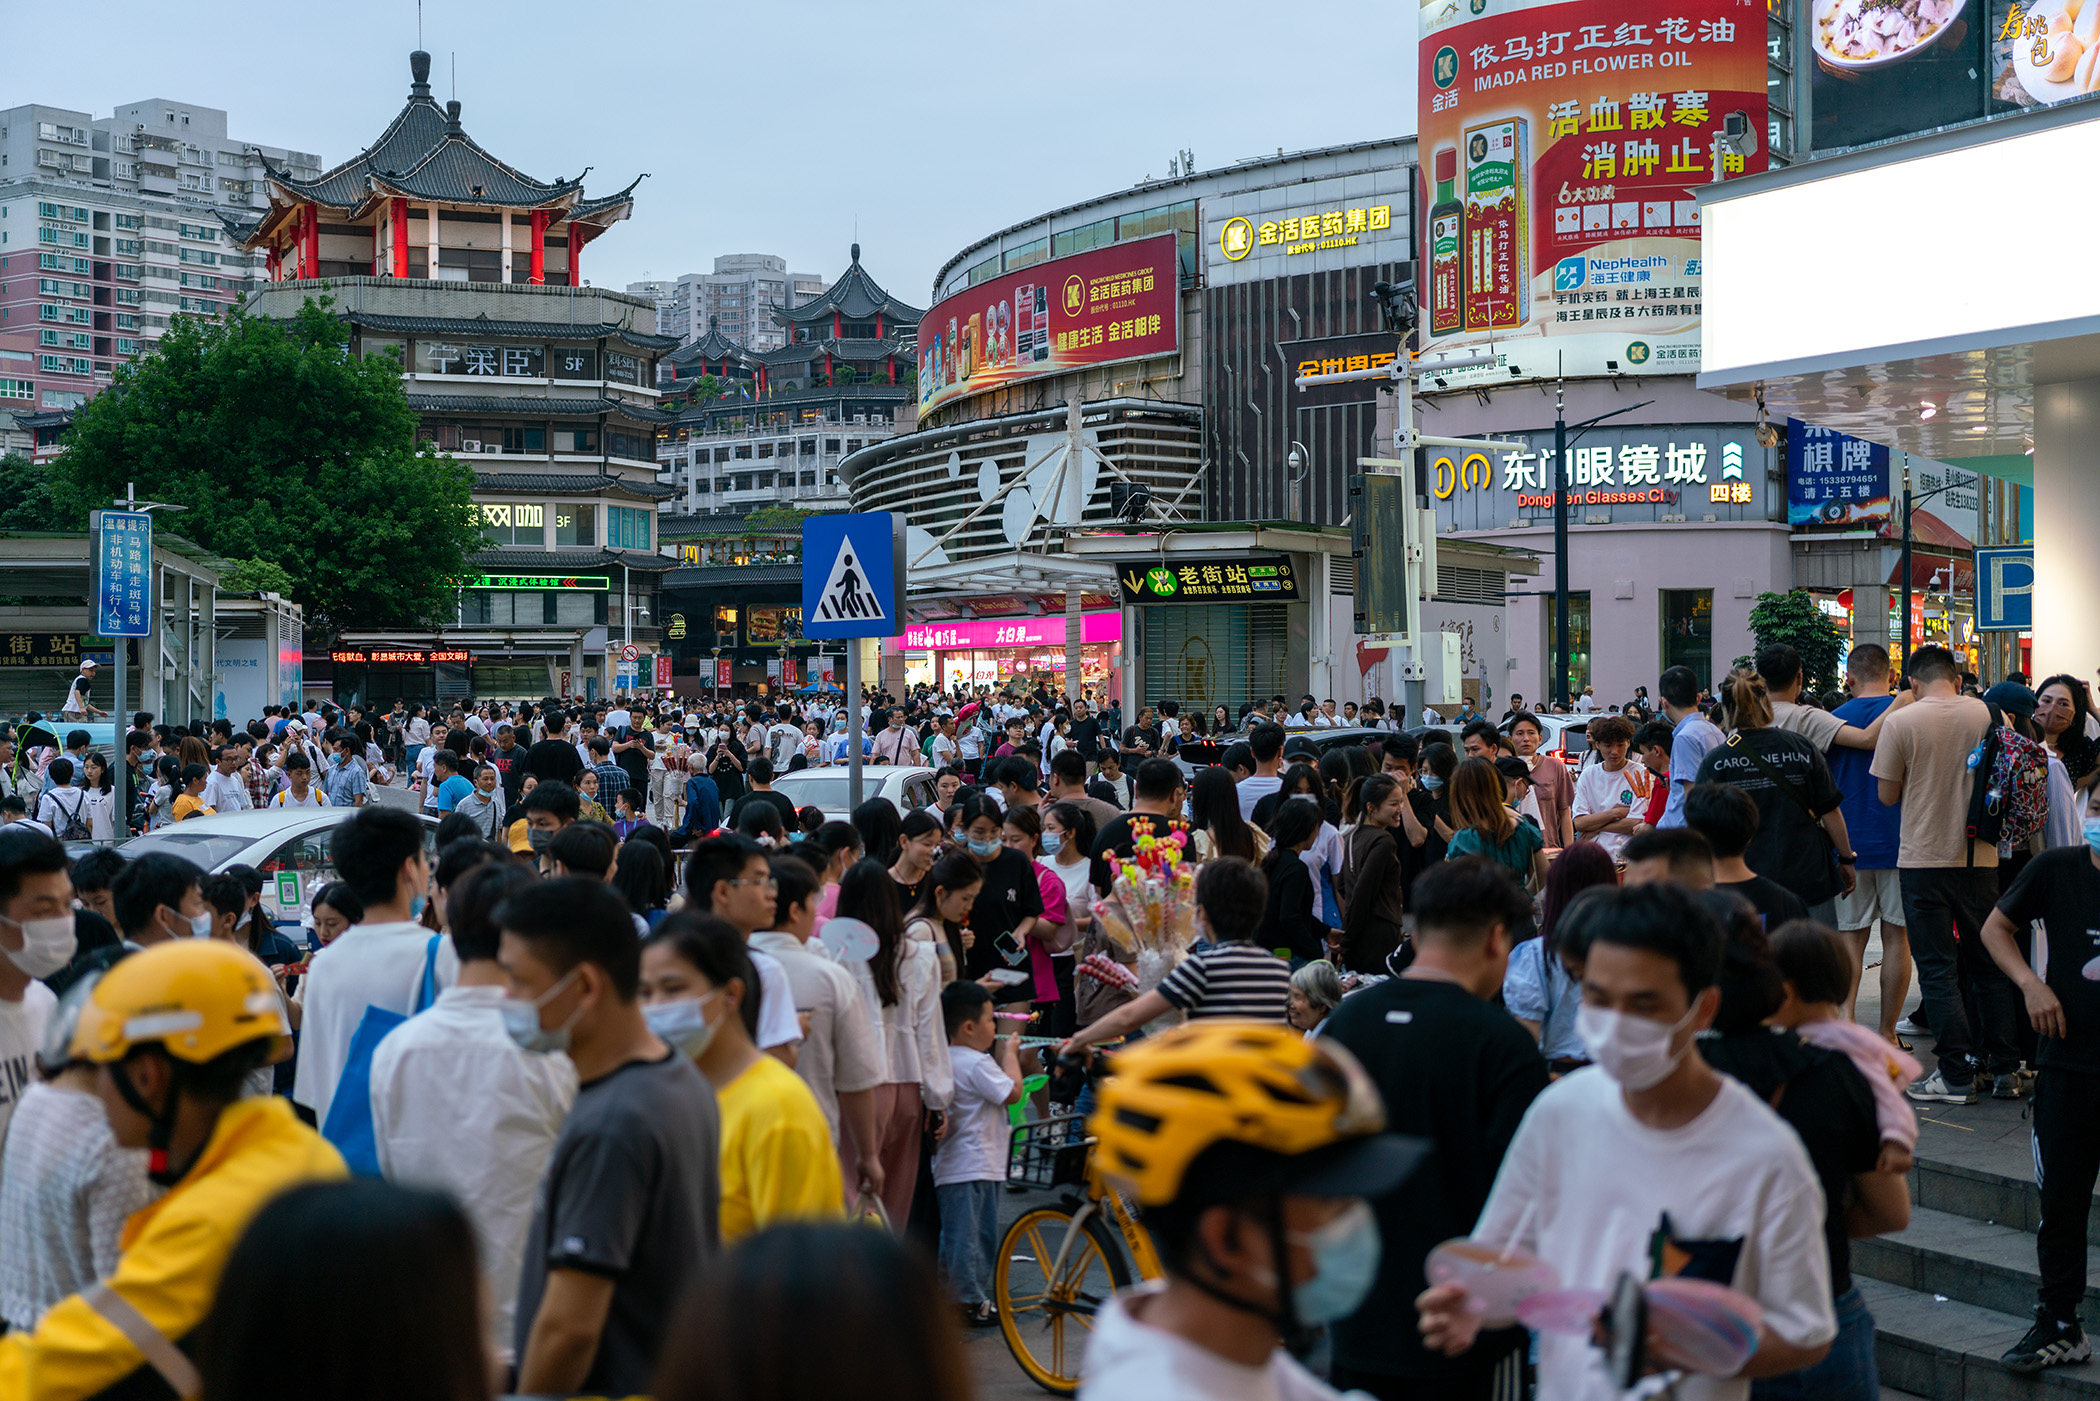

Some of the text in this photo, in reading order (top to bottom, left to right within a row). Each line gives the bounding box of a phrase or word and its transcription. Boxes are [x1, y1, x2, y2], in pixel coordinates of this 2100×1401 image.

[1469, 16, 1736, 71] 依马打正红花油
[1998, 2, 2054, 67] 寿桃包
[1474, 51, 1692, 92] IMADA RED FLOWER OIL
[1432, 88, 1458, 114] 金活
[1547, 90, 1710, 138] 活血散寒
[1558, 181, 1616, 205] 6大功效
[1258, 204, 1391, 246] 金活医药集团
[1498, 219, 1509, 294] 依马打正红花油
[1590, 255, 1668, 271] NepHealth
[1089, 275, 1154, 302] 金活医药集团
[1590, 270, 1651, 285] 海王健康
[1556, 286, 1701, 305] 手机买药 就上海王星辰
[1057, 314, 1161, 352] 健康生活 金活相伴
[427, 345, 533, 376] 宁采臣
[565, 357, 585, 372] 5F
[1656, 349, 1701, 359] 金活医药
[1502, 441, 1707, 491] 东门眼镜城
[1803, 440, 1871, 473] 棋牌
[1518, 488, 1679, 508] Dongen Glasses City
[1710, 482, 1752, 504] 四楼
[1804, 484, 1871, 500] 请上五楼
[104, 517, 149, 533] 温馨提示
[556, 515, 571, 528] 3F
[108, 534, 123, 630] 非机动车和行人过
[128, 536, 142, 626] 马路请走斑马线
[498, 577, 560, 587] 沉浸式体验馆
[1178, 564, 1249, 585] 老街站
[1991, 556, 2034, 621] P
[9, 635, 76, 655] 街站
[995, 626, 1026, 644] 大白兔
